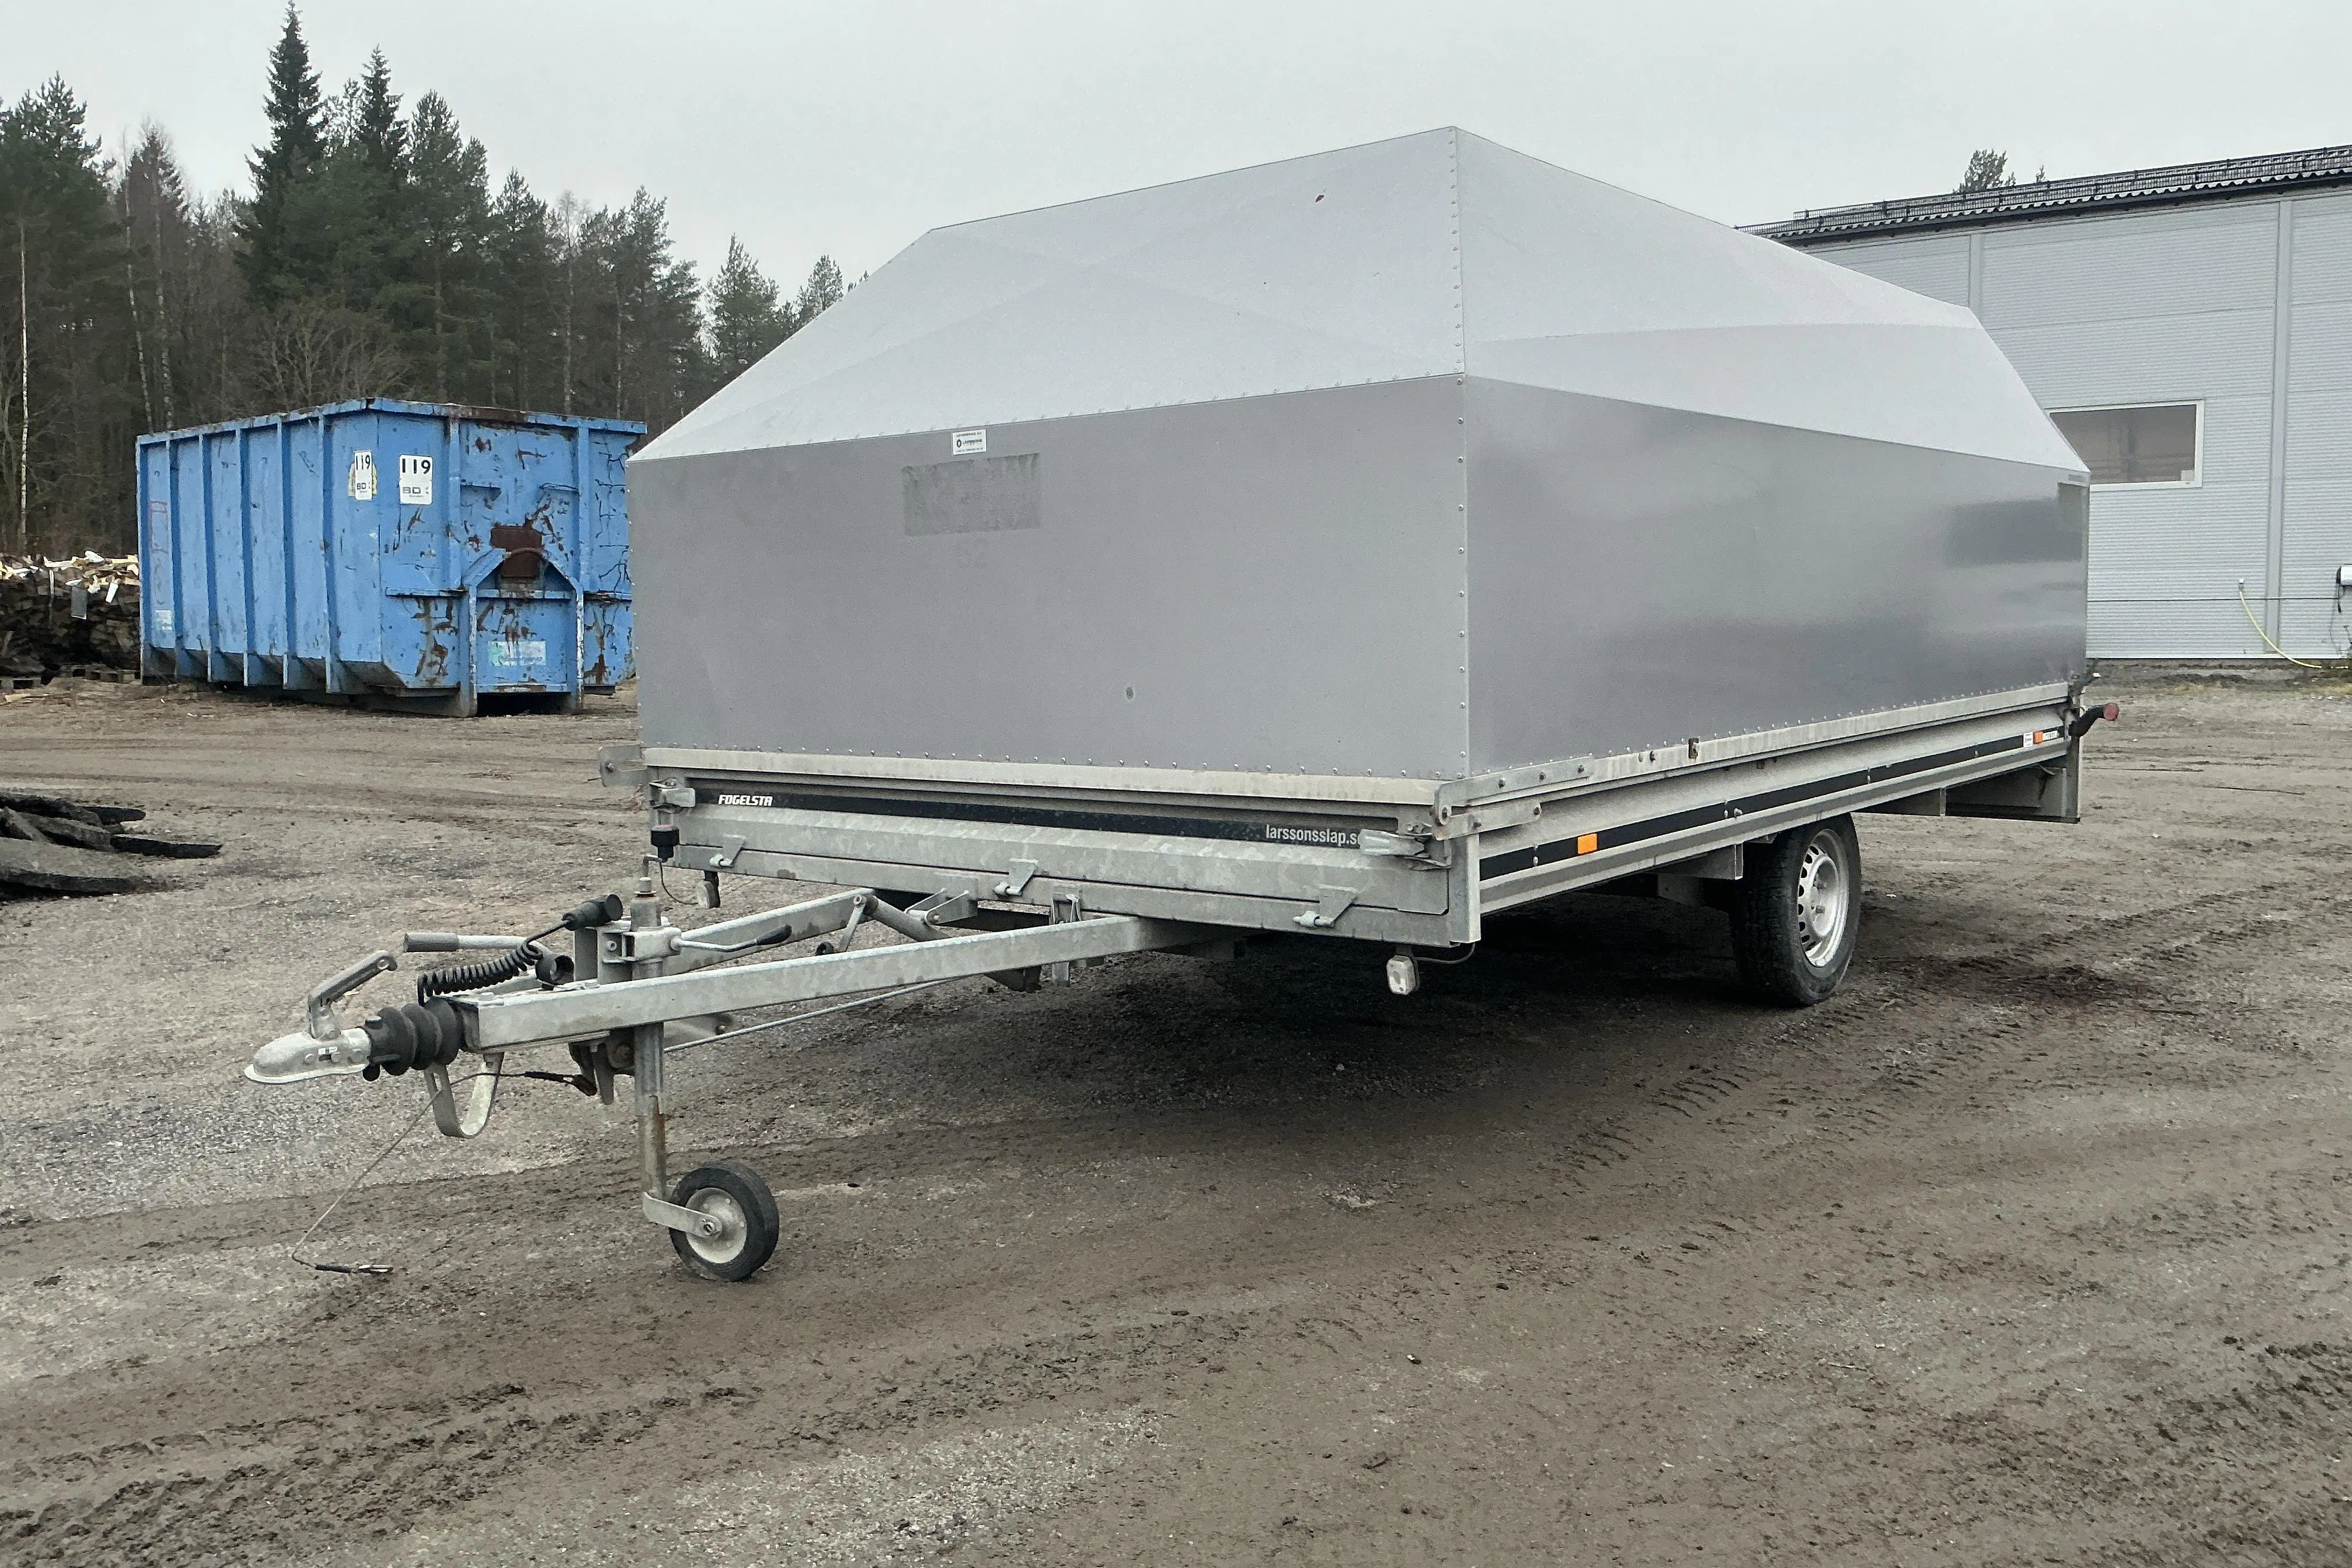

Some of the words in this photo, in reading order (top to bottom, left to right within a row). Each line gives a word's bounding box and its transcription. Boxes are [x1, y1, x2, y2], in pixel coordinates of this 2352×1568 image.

[356, 455, 370, 470] 119
[402, 458, 430, 474] 119
[718, 794, 773, 806] FOGELSTA
